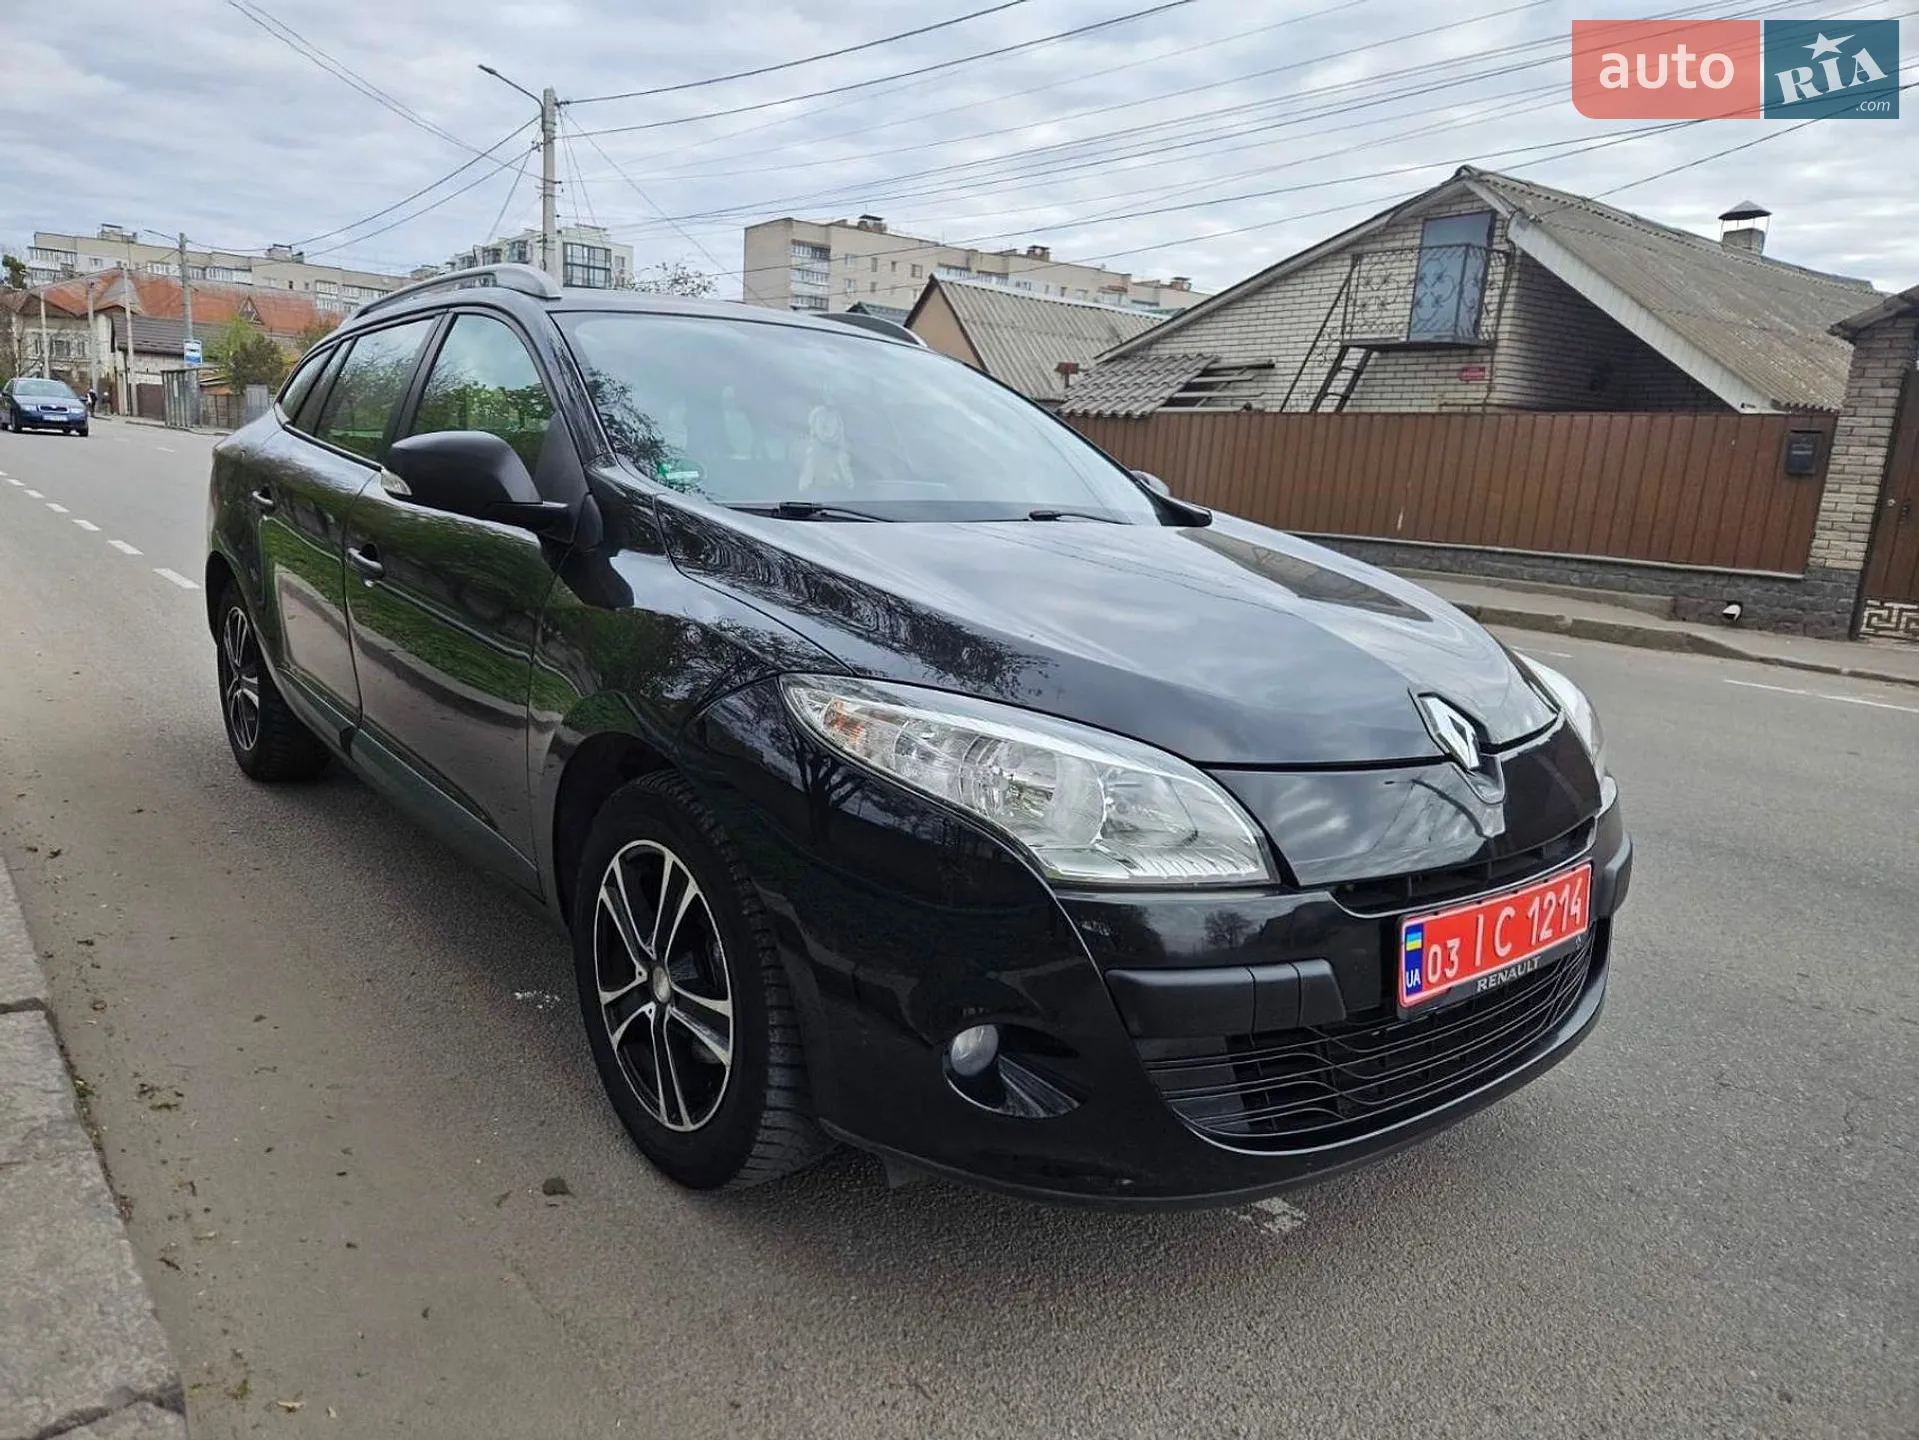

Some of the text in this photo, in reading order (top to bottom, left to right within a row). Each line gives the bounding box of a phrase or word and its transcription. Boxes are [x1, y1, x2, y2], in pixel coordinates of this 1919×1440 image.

[1427, 937, 1461, 984] 03
[1527, 877, 1584, 946] 1214
[1405, 968, 1422, 989] UA
[1476, 954, 1542, 993] RENAULT
